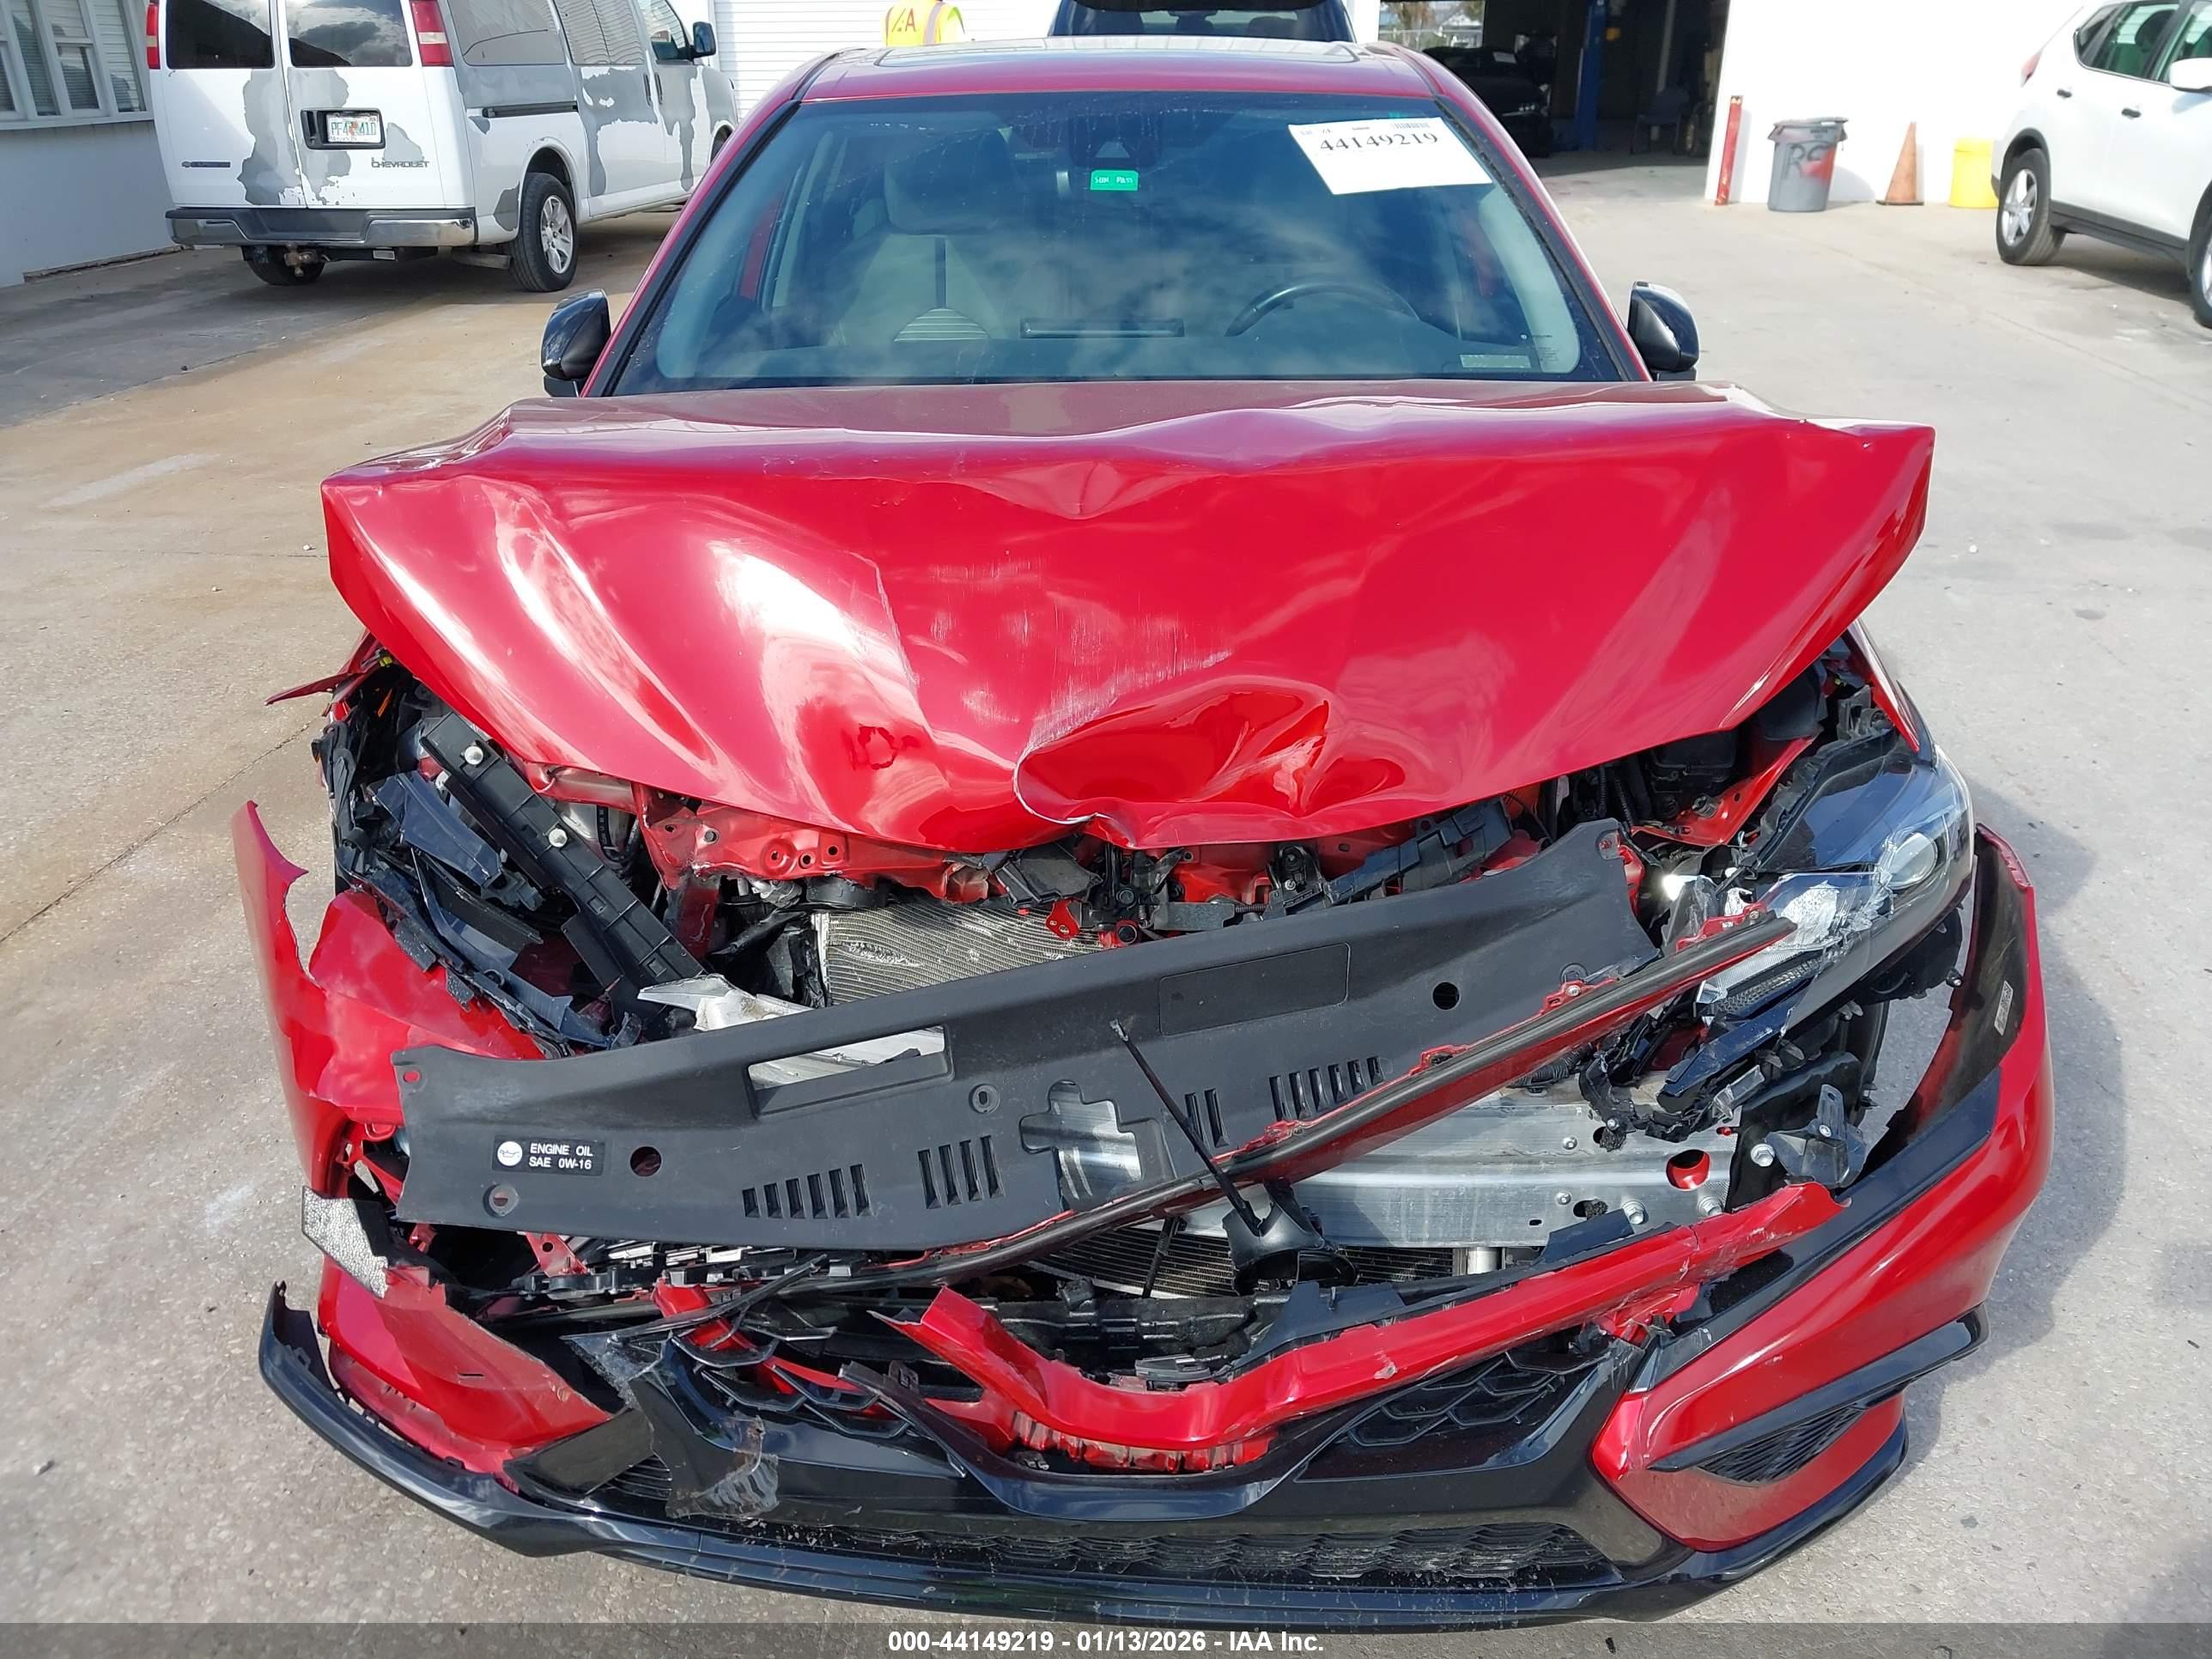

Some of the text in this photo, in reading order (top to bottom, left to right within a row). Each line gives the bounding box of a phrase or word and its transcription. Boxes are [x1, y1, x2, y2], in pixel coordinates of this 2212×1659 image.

[1321, 132, 1438, 151] 44149219
[371, 160, 429, 168] CHEVROLET
[530, 1143, 593, 1157] ENGINE OIL
[529, 1156, 592, 1170] SAE 0W-16
